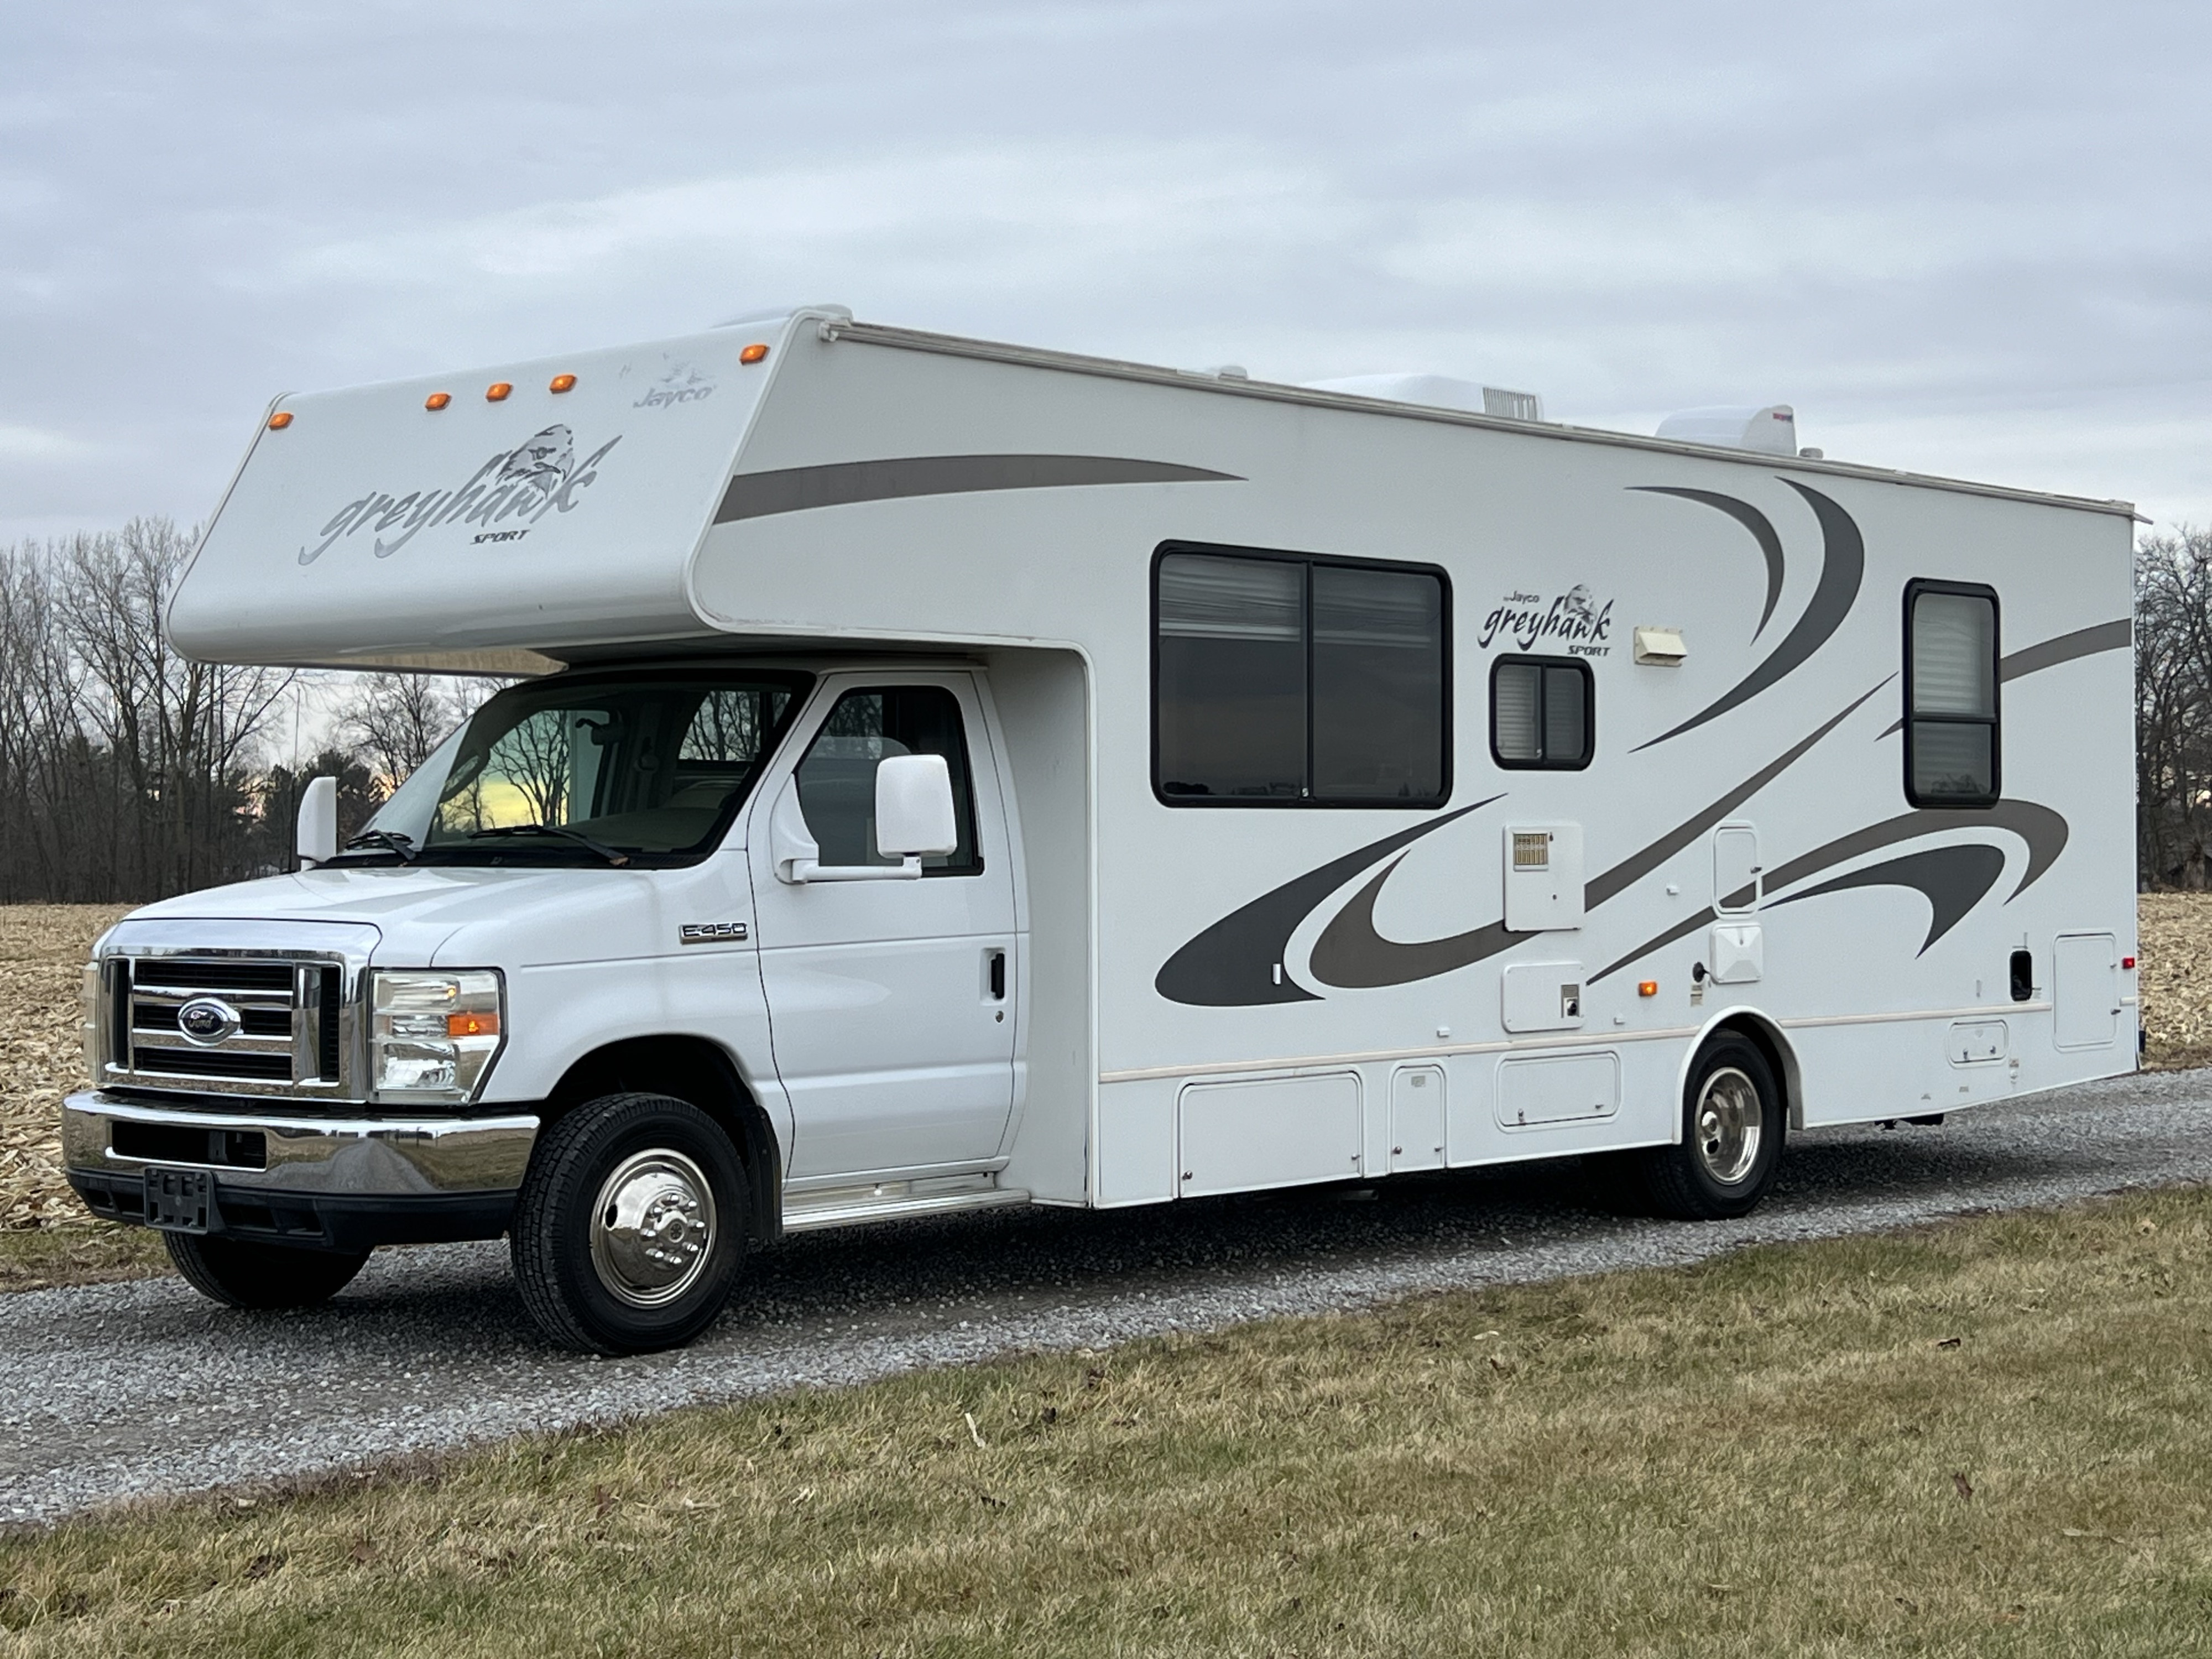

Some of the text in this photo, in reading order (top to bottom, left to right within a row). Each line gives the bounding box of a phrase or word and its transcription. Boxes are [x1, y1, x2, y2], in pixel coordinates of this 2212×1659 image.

[633, 387, 713, 409] Jayco
[298, 435, 623, 565] greyhawk
[469, 529, 530, 545] SPORT
[1509, 590, 1540, 604] Jayco
[1477, 595, 1614, 651] greyhawk
[1567, 645, 1610, 656] SPORT
[682, 922, 747, 937] E-450
[189, 1010, 215, 1028] Ford
